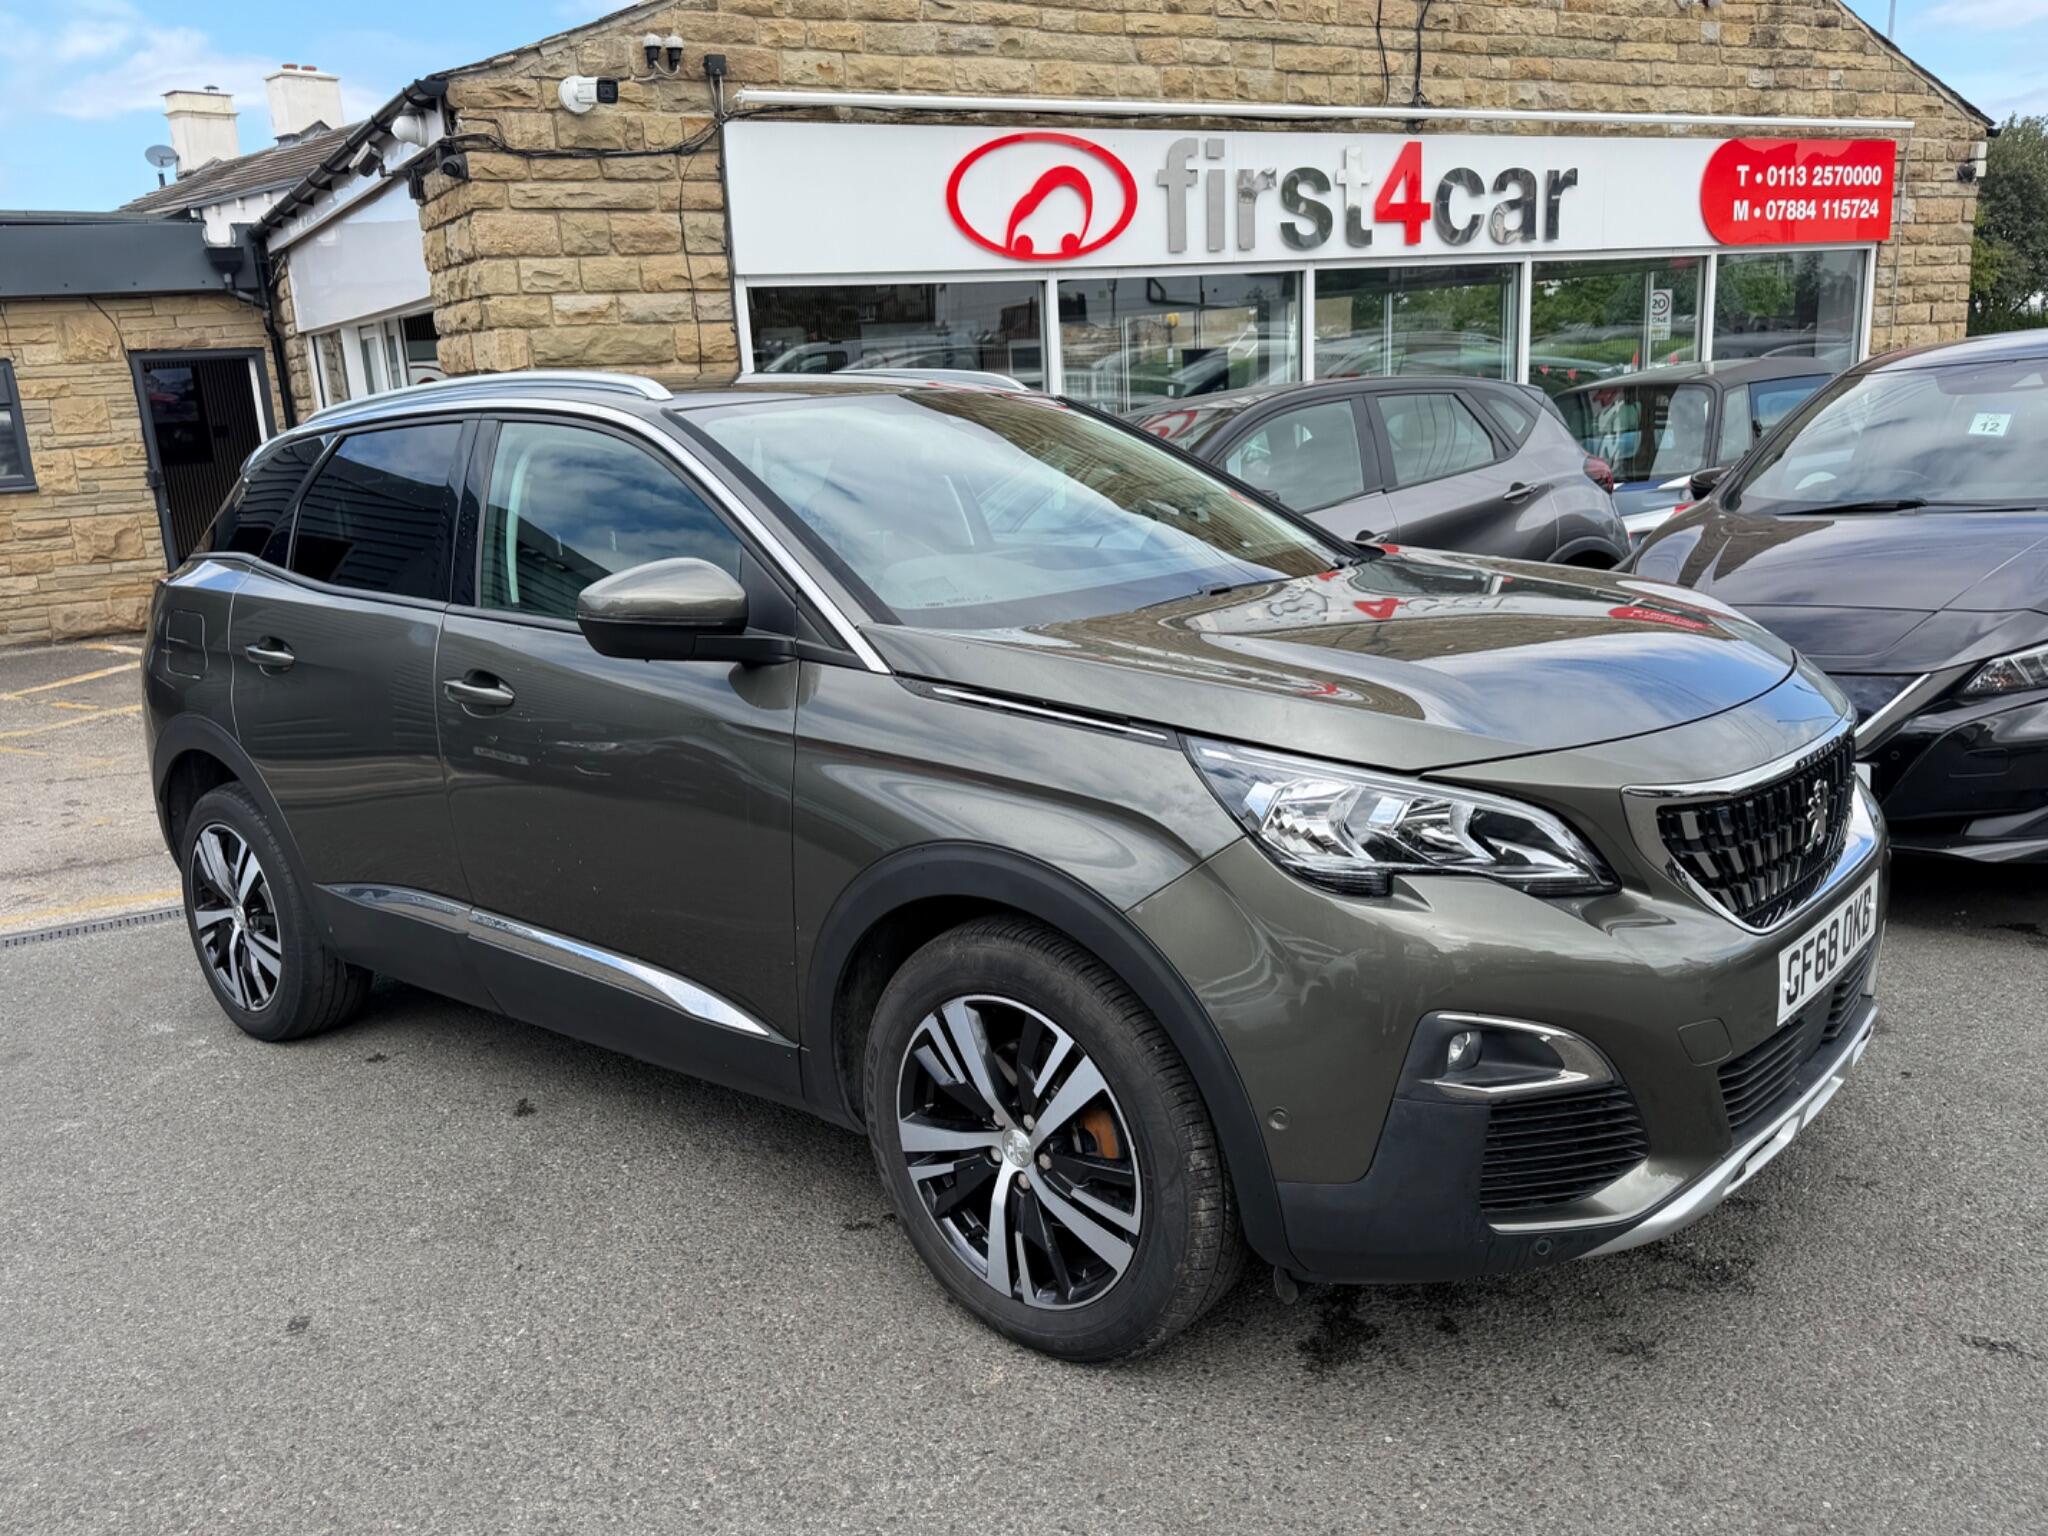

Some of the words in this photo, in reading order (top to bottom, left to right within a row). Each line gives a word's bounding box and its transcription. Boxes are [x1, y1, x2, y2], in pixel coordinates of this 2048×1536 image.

[1157, 137, 1578, 253] first4car
[1736, 165, 1750, 187] T
[1766, 165, 1807, 187] 0113
[1812, 165, 1882, 187] 2570000
[1733, 200, 1749, 222] M
[1765, 200, 1817, 221] 07884
[1822, 198, 1880, 220] 115724
[1786, 918, 1840, 1006] GF68
